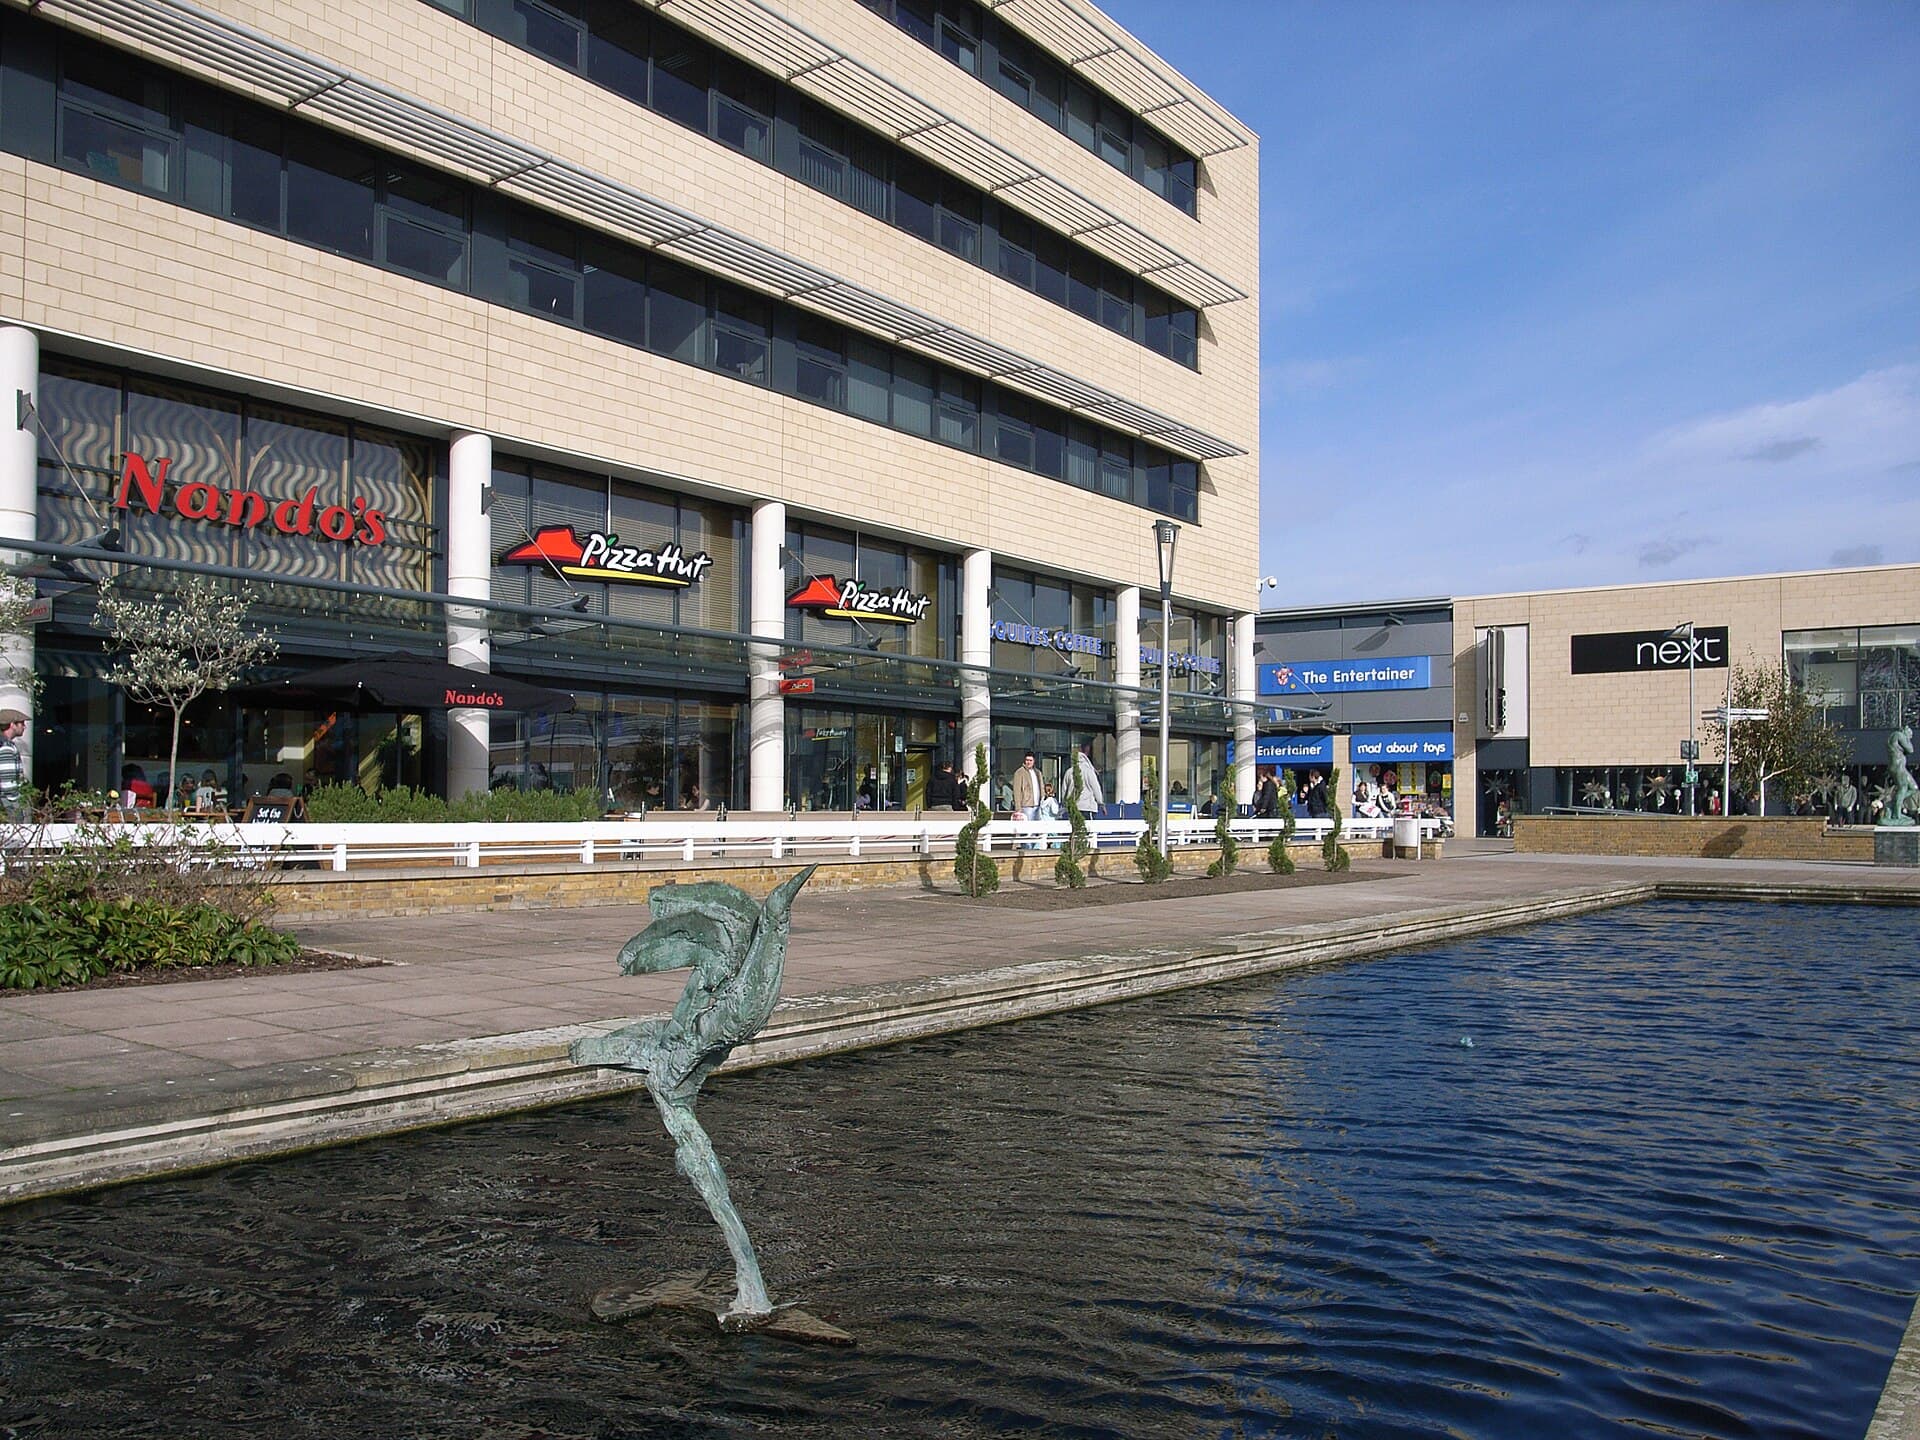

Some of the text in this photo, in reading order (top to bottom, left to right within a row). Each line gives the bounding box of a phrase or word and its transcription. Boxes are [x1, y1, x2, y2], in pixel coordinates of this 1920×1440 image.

[112, 451, 387, 546] Nando's
[580, 533, 713, 578] Pizza Hut
[839, 580, 931, 617] Pizza Hut
[1053, 630, 1102, 656] COFFEE
[1636, 637, 1721, 665] next
[1303, 667, 1416, 684] The Entertainer
[445, 689, 504, 706] Nando's
[1257, 744, 1322, 757] Entertainer
[1357, 741, 1447, 756] mad about toys
